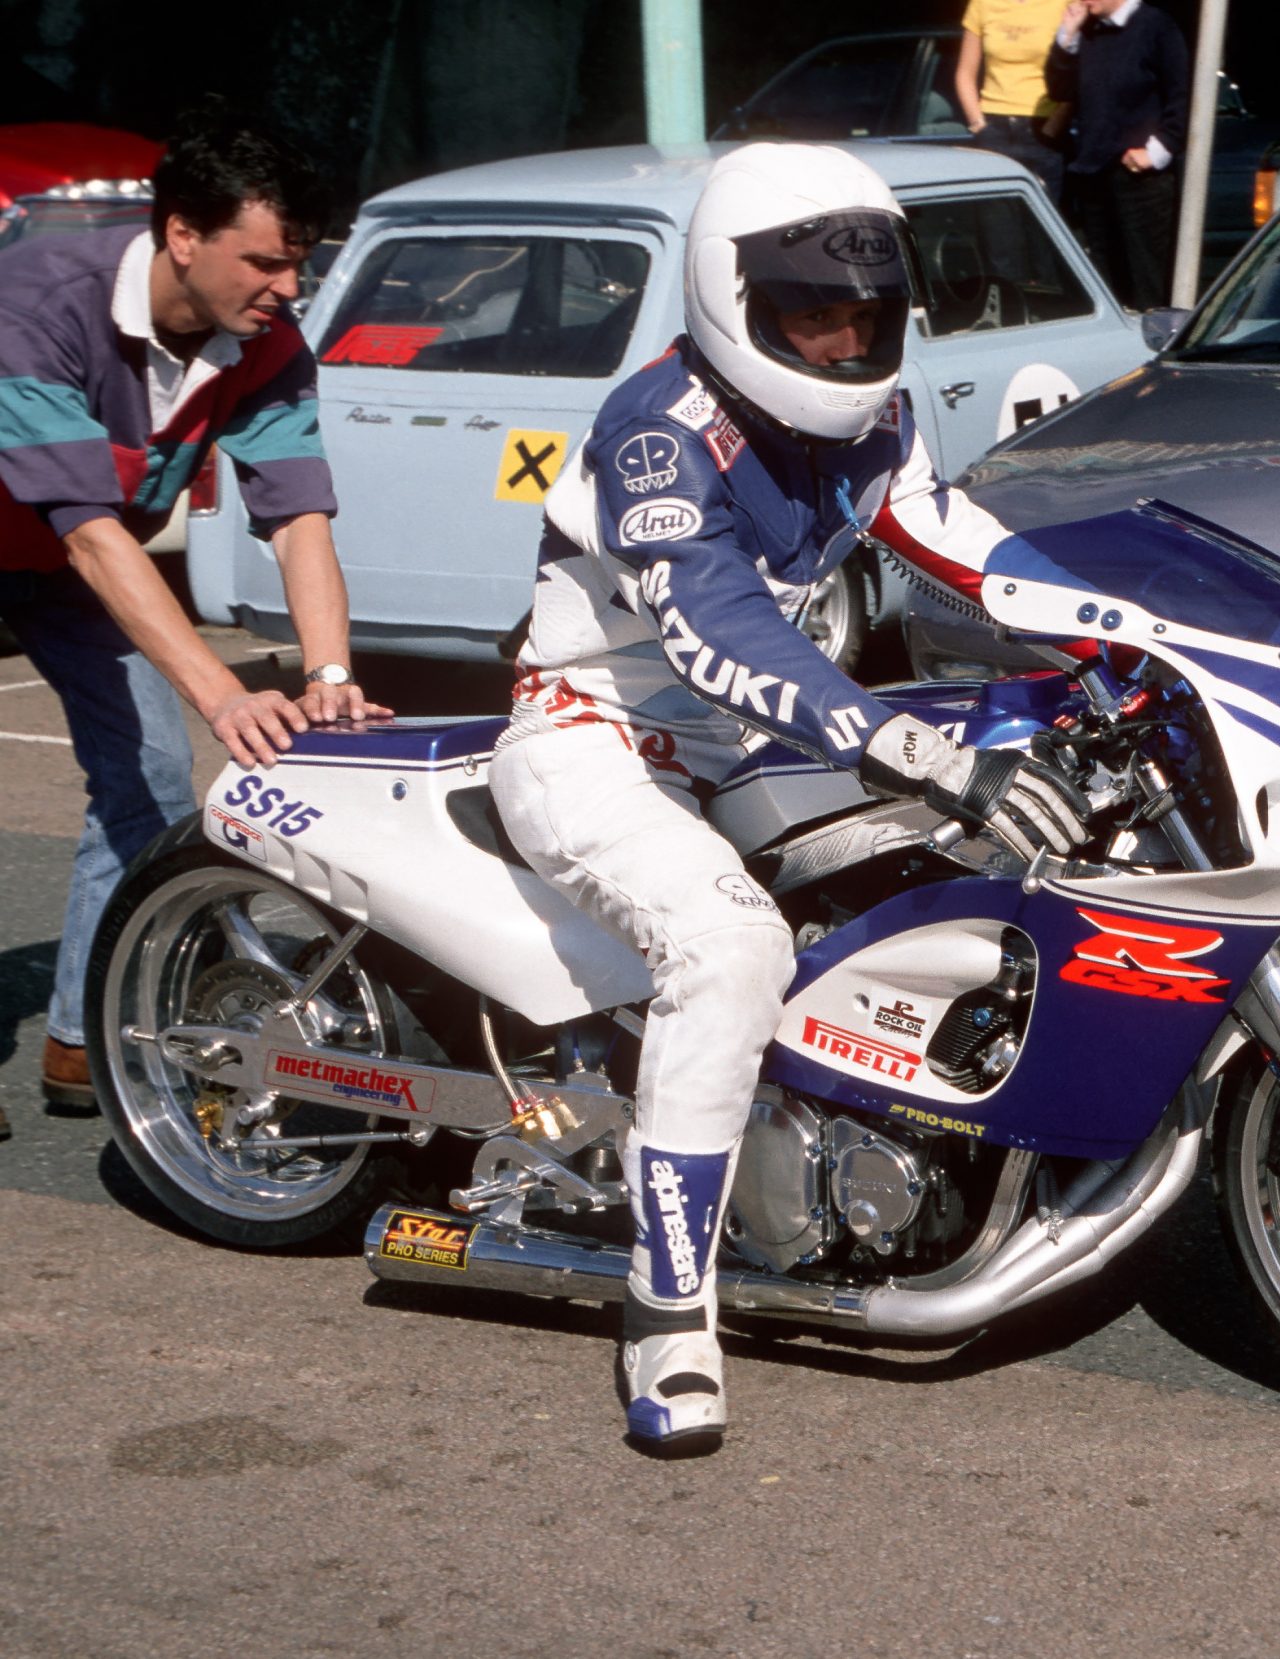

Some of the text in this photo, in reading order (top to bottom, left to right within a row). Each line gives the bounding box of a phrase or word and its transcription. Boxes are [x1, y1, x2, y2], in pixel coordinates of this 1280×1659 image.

[831, 228, 891, 254] Arai
[626, 509, 687, 534] Arai
[642, 528, 672, 540] HELMET
[640, 560, 800, 723] SUZUKI
[224, 775, 325, 837] SS15
[1072, 906, 1224, 979] R
[1059, 959, 1232, 1003] GSX
[875, 1011, 923, 1033] ROCK OIL
[802, 1015, 922, 1082] PIRELLI
[275, 1055, 418, 1111] metmachex
[332, 1083, 402, 1106] engineering
[906, 1107, 985, 1137] PRO-BOLT
[648, 1160, 699, 1294] alpinestars
[387, 1241, 459, 1265] PRO SERIES
